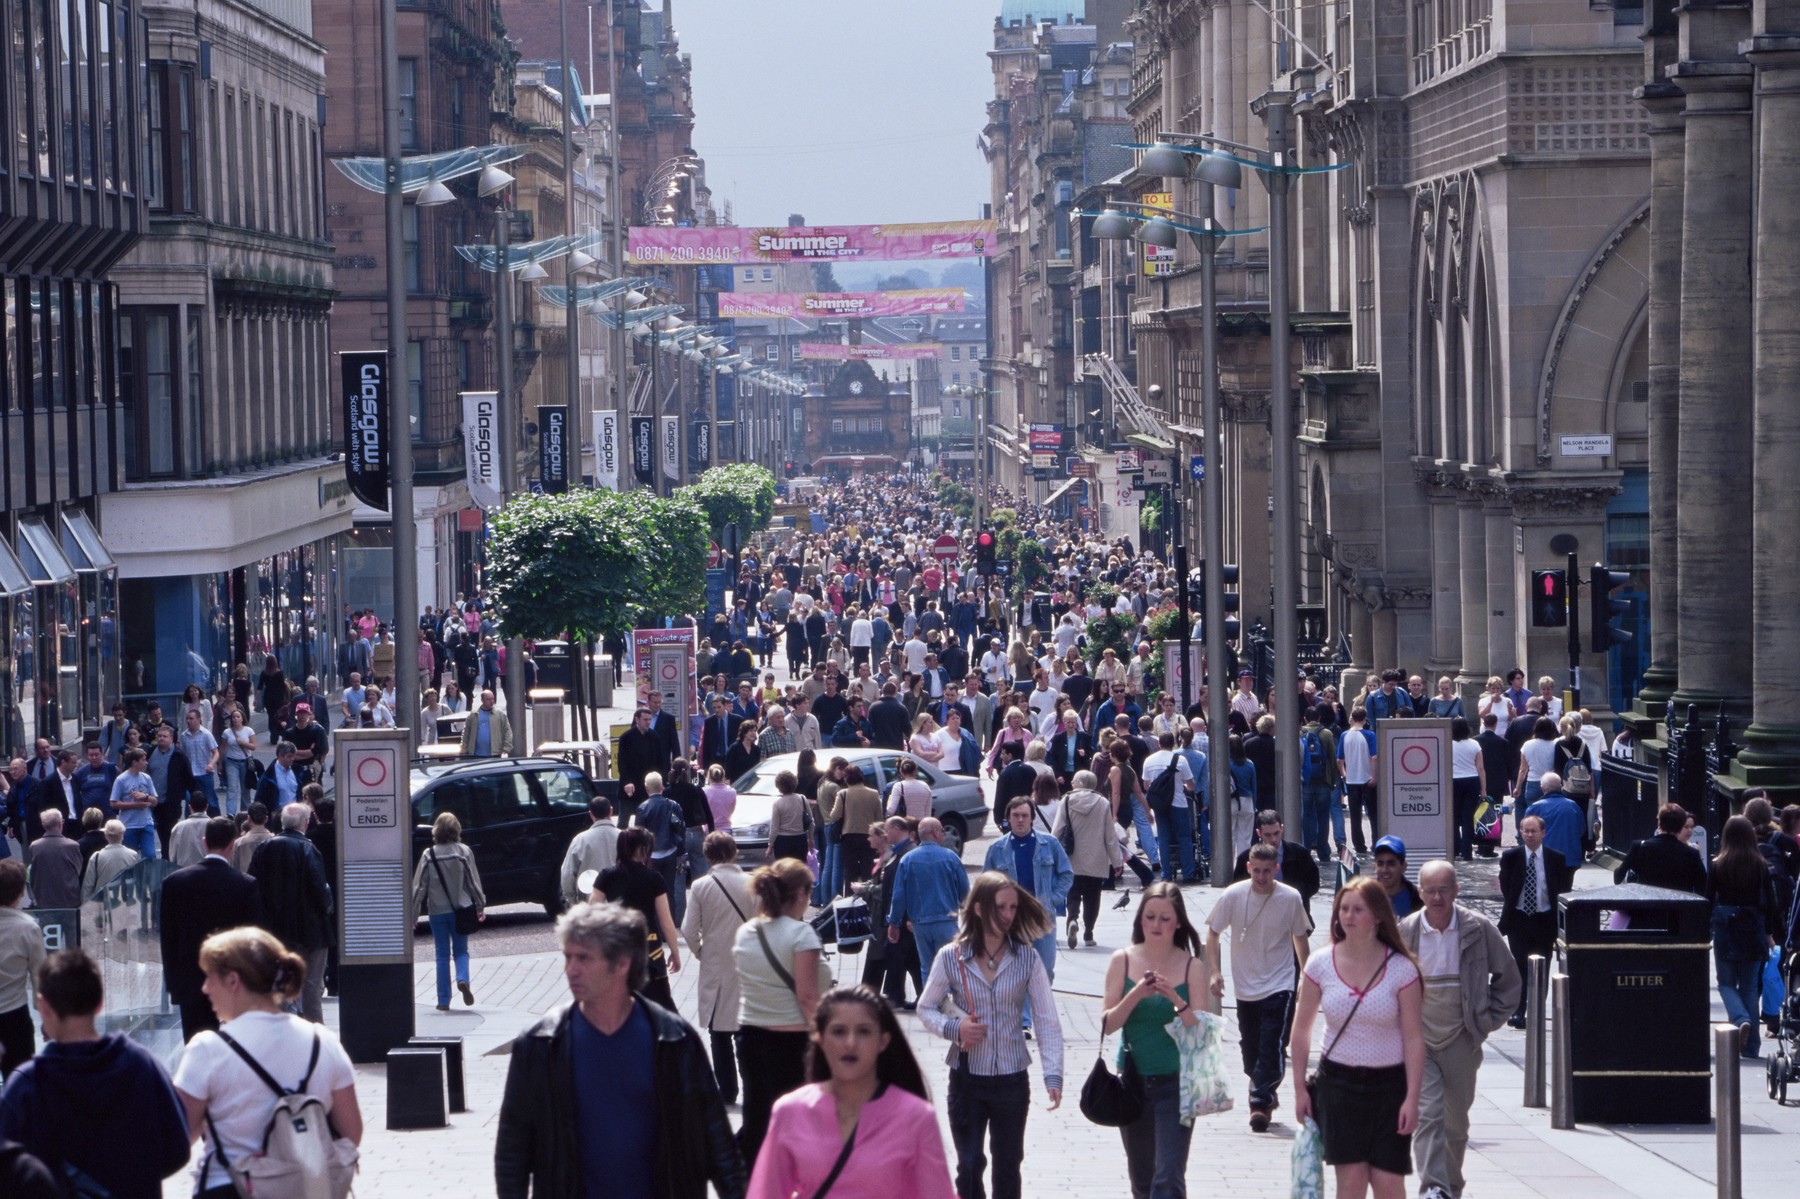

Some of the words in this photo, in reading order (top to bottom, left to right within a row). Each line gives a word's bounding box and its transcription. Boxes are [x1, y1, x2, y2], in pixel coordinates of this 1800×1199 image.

[1144, 194, 1158, 204] TO
[1163, 194, 1172, 203] LE
[758, 235, 847, 251] Summer
[636, 246, 663, 261] 0871
[670, 246, 694, 261] 200
[698, 246, 730, 261] 3940
[765, 305, 787, 315] 3940
[806, 298, 865, 309] Summer
[350, 395, 359, 430] Scotland
[358, 363, 380, 463] Glasgow
[351, 432, 360, 452] with
[475, 401, 492, 477] Glasgow
[548, 412, 562, 477] Glasgow
[602, 416, 614, 469] Glasgow
[639, 421, 650, 467] Glasgow
[666, 421, 676, 461] Glasgow
[701, 424, 709, 460] Glasgow
[654, 634, 677, 644] minute
[641, 646, 650, 654] bu
[1401, 803, 1432, 812] ENDS
[357, 815, 388, 824] ENDS
[1616, 975, 1664, 986] LITTER
